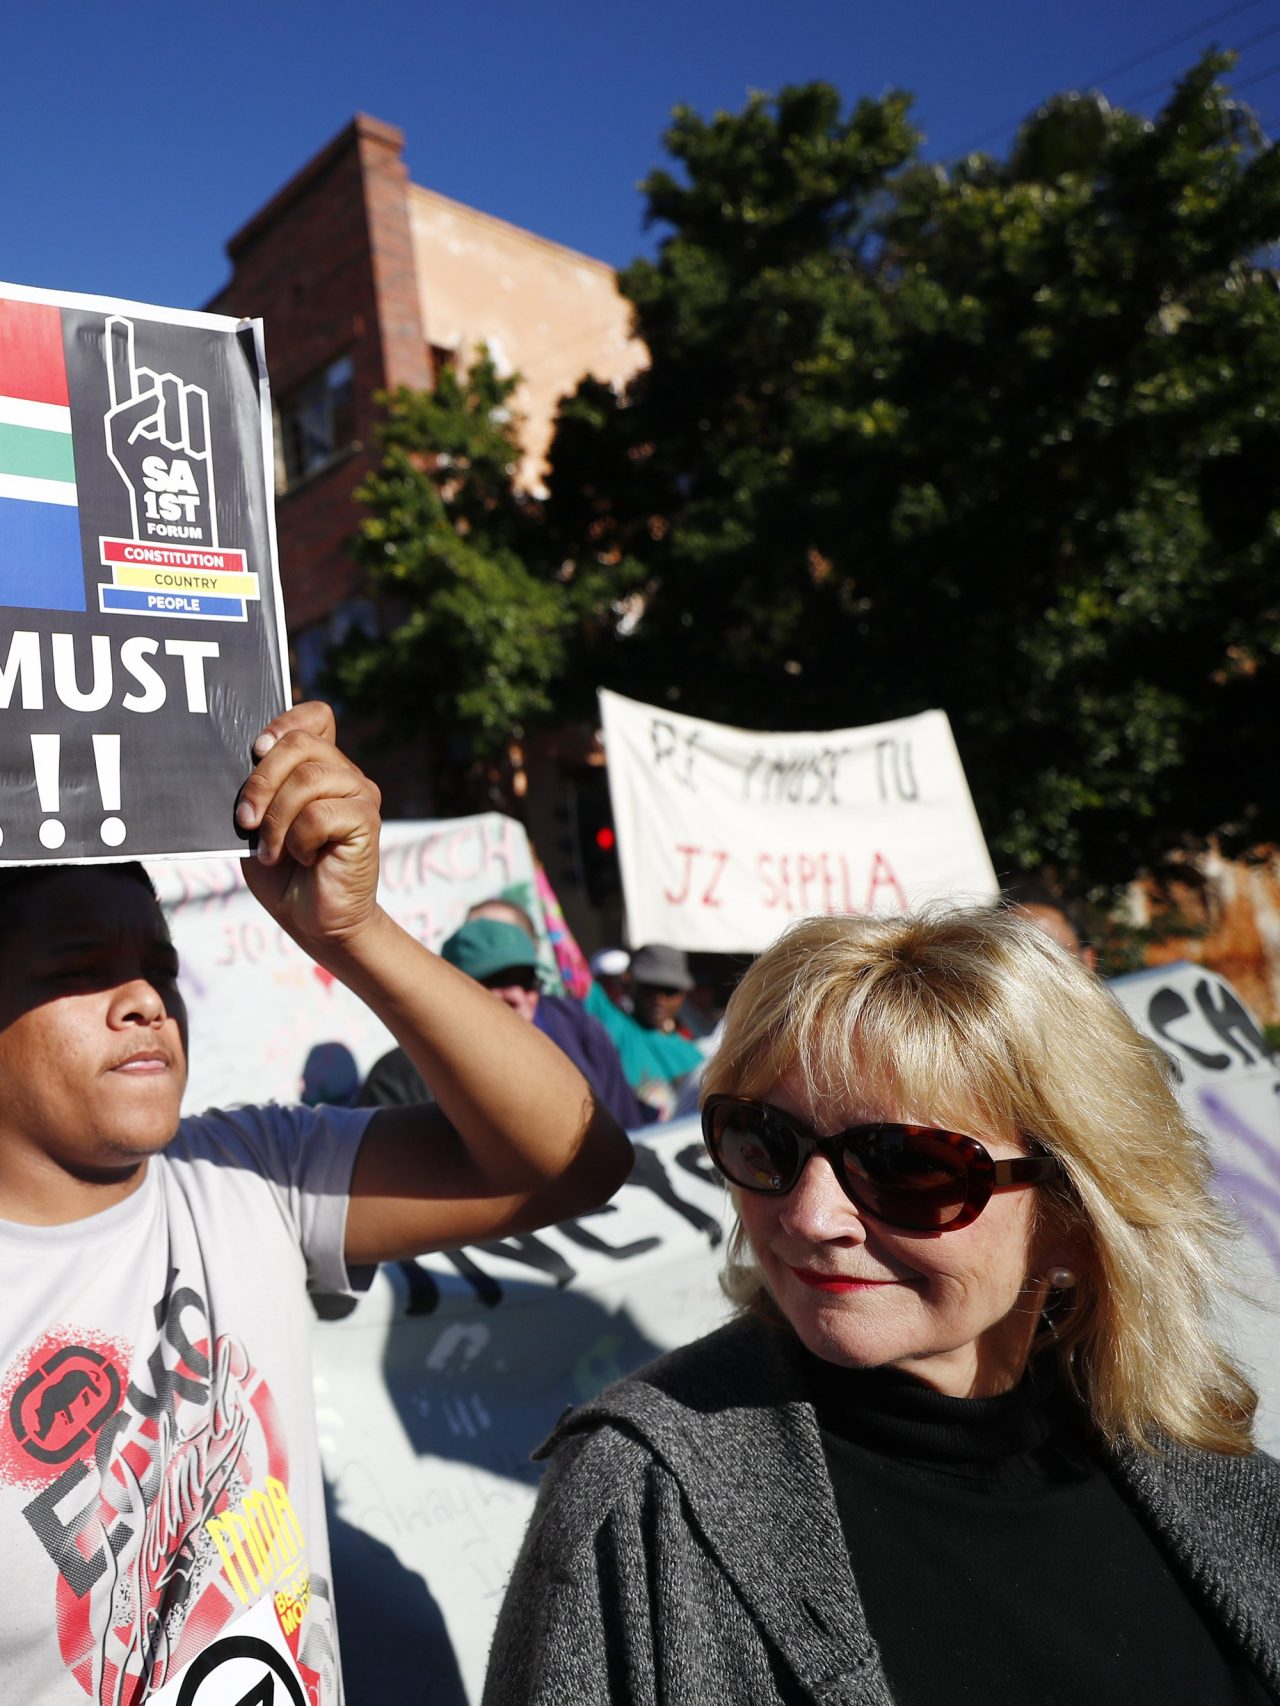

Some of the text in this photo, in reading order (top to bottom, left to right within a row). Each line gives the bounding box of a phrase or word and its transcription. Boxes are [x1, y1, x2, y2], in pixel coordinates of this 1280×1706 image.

[141, 455, 201, 495] SA
[143, 492, 201, 523] 1ST
[147, 522, 202, 540] FORUM
[123, 546, 225, 569] CONSTITUTION
[154, 573, 218, 590] COUNTRY
[147, 595, 201, 612] PEOPLE
[663, 842, 730, 908] JZ
